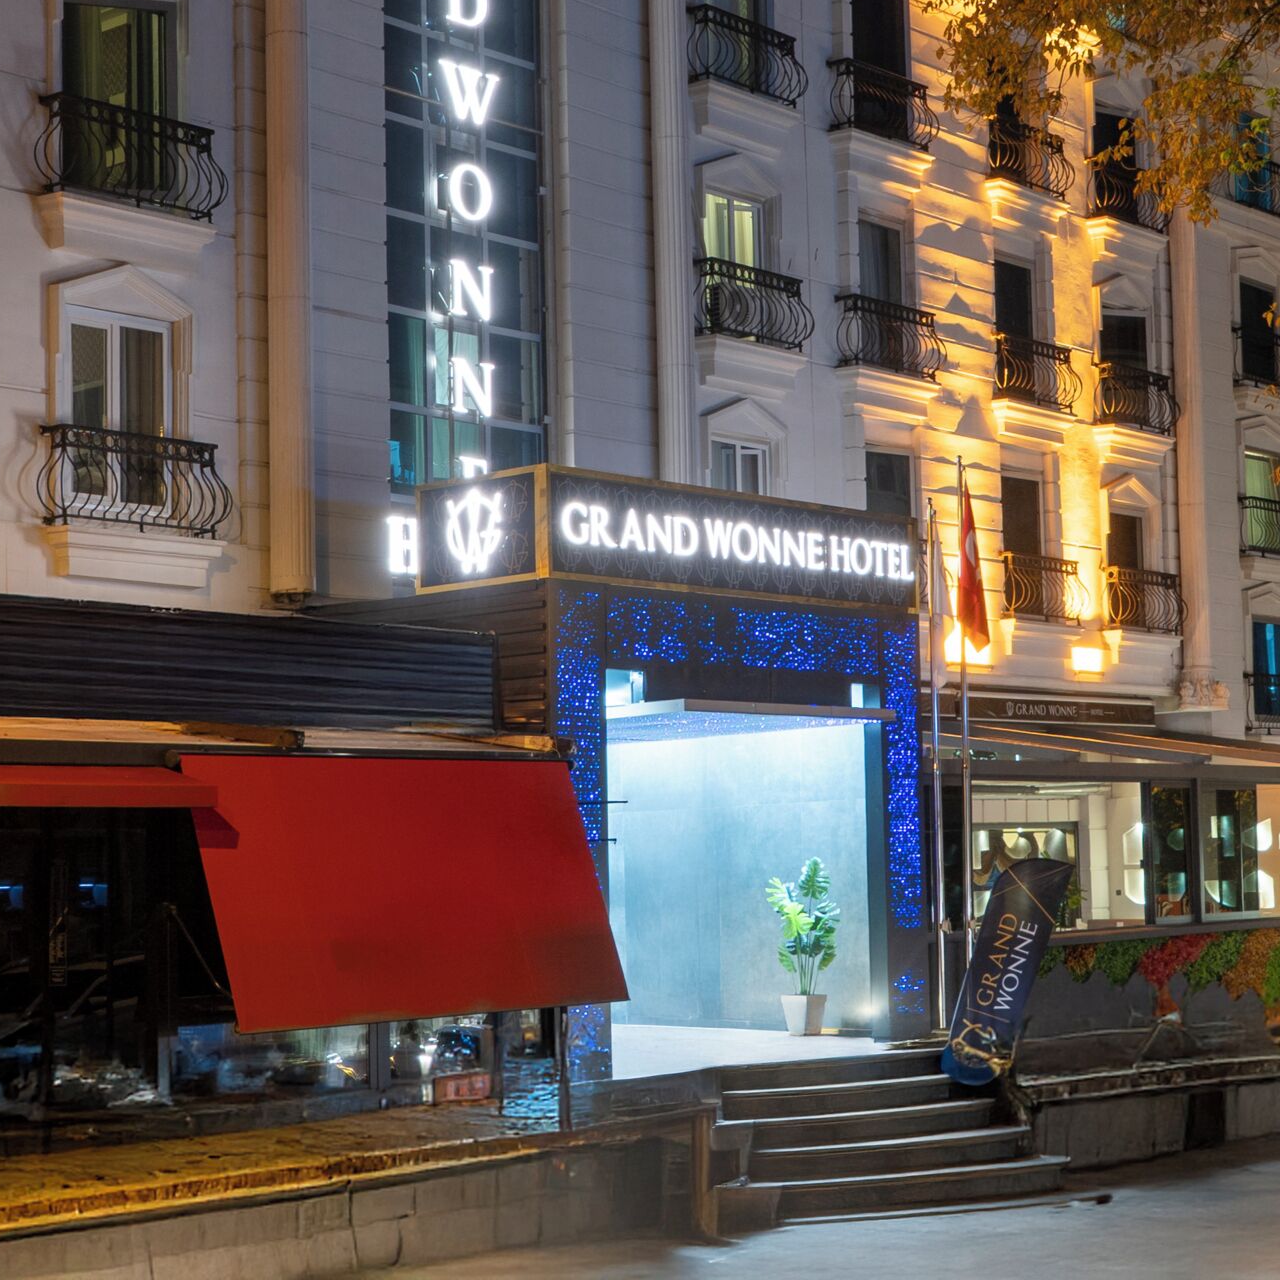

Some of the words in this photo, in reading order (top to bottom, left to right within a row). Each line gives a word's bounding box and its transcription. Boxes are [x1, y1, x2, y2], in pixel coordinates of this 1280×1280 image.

[561, 503, 698, 556] GRAND
[704, 519, 827, 570] WONNE
[830, 535, 914, 580] HOTEL
[1016, 703, 1046, 715] GRAND
[1049, 704, 1078, 717] WONNE
[976, 913, 1017, 1006] GRAND
[993, 920, 1038, 1010] WONNE
